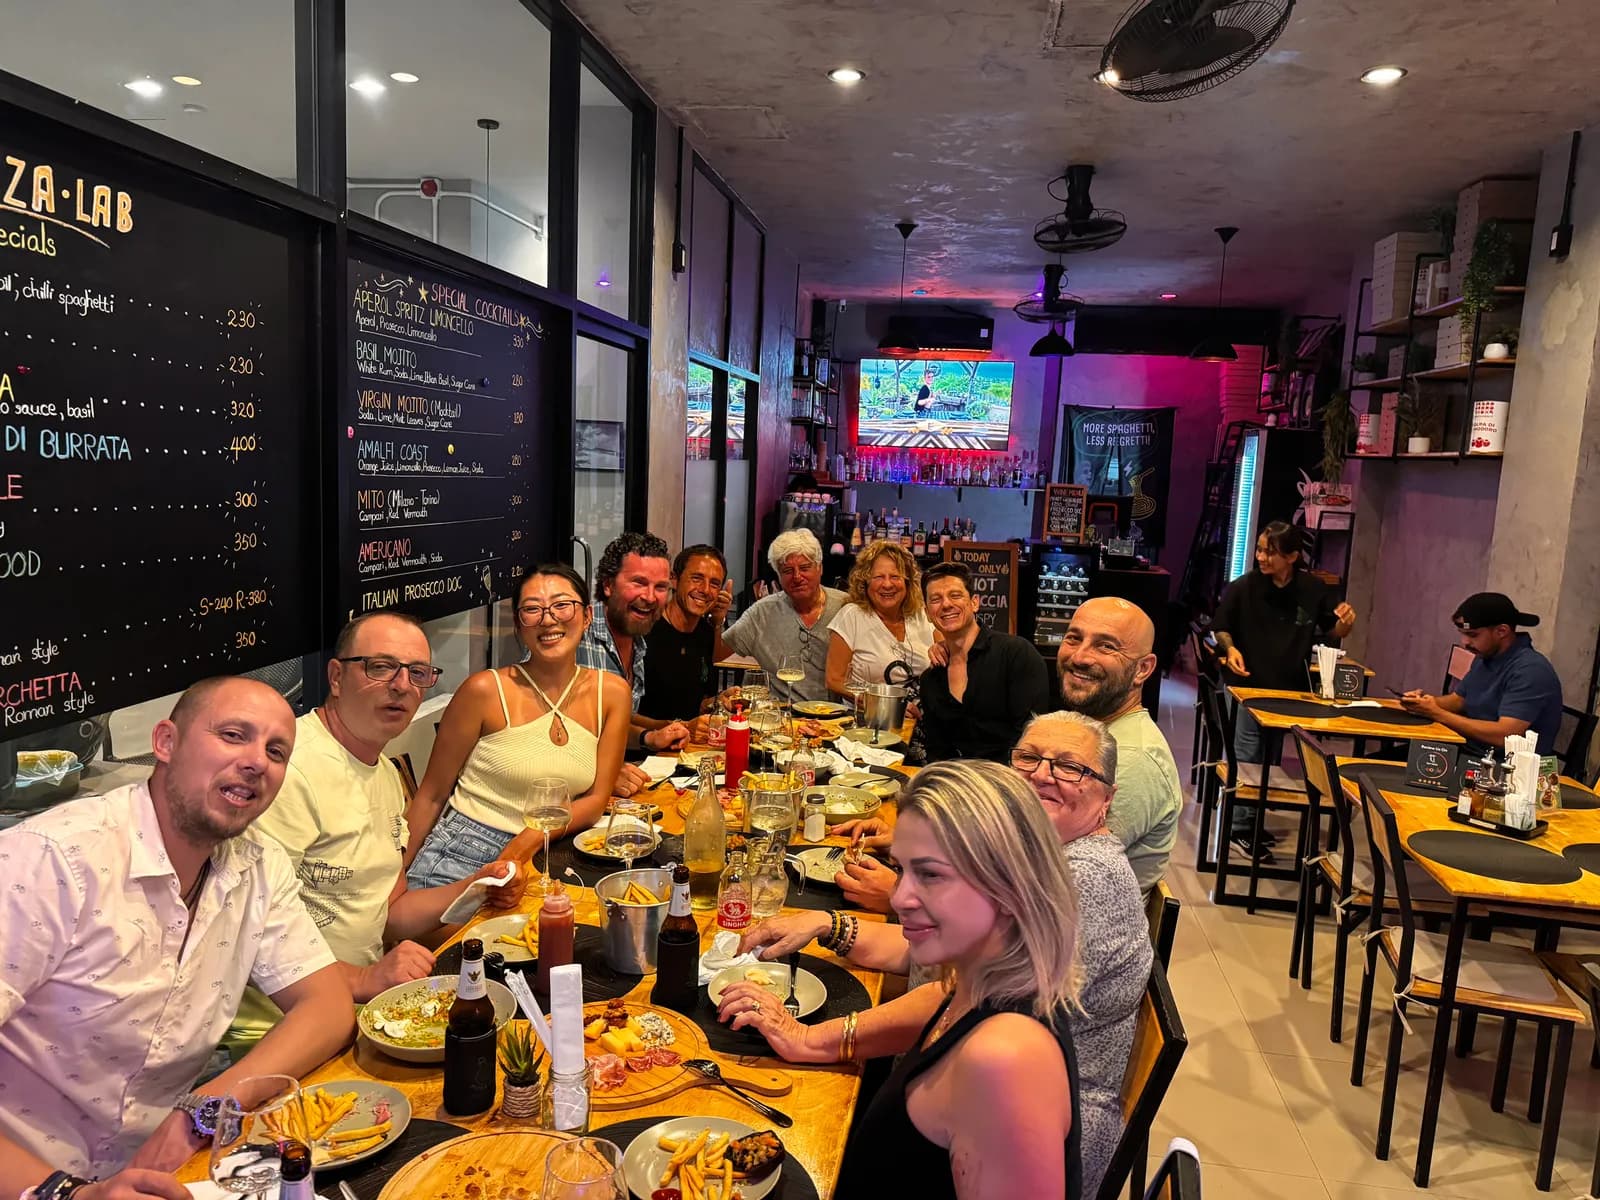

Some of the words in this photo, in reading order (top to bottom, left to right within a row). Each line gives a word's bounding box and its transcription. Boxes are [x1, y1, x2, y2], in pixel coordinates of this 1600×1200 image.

[22, 277, 55, 300] chilli
[59, 284, 115, 316] spaghetti
[431, 283, 470, 311] SPECIAL
[475, 298, 520, 327] COCKTAILS
[227, 309, 256, 328] 230
[353, 288, 393, 317] APEROL
[395, 300, 426, 324] SPRITZ
[430, 308, 475, 336] LIMONCELLO
[356, 339, 380, 362] BASIL
[383, 346, 417, 369] MOJITO
[229, 356, 254, 375] 230
[67, 397, 95, 419] basil
[230, 400, 255, 419] 320
[357, 389, 392, 410] VIRGIN
[398, 395, 428, 415] MOJITO
[1083, 423, 1105, 433] MORE
[5, 425, 26, 452] DI
[40, 429, 132, 461] BURRATA
[230, 435, 256, 460] 400
[357, 440, 394, 460] AMALFI
[400, 444, 429, 461] COAST
[1086, 436, 1105, 446] LESS
[234, 492, 258, 507] 300
[357, 490, 385, 510] MITO
[234, 532, 257, 551] 350
[358, 538, 412, 562] AMERICANO
[962, 551, 990, 562] TODAY
[978, 564, 1001, 574] ONLY
[362, 588, 399, 611] ITALIAN
[405, 579, 445, 602] PROSECCO
[447, 576, 463, 593] DOC
[974, 577, 998, 591] OT
[979, 594, 1008, 608] CCIA
[236, 632, 256, 648] 350
[31, 638, 60, 665] style
[5, 703, 55, 727] Roman
[63, 690, 96, 714] style
